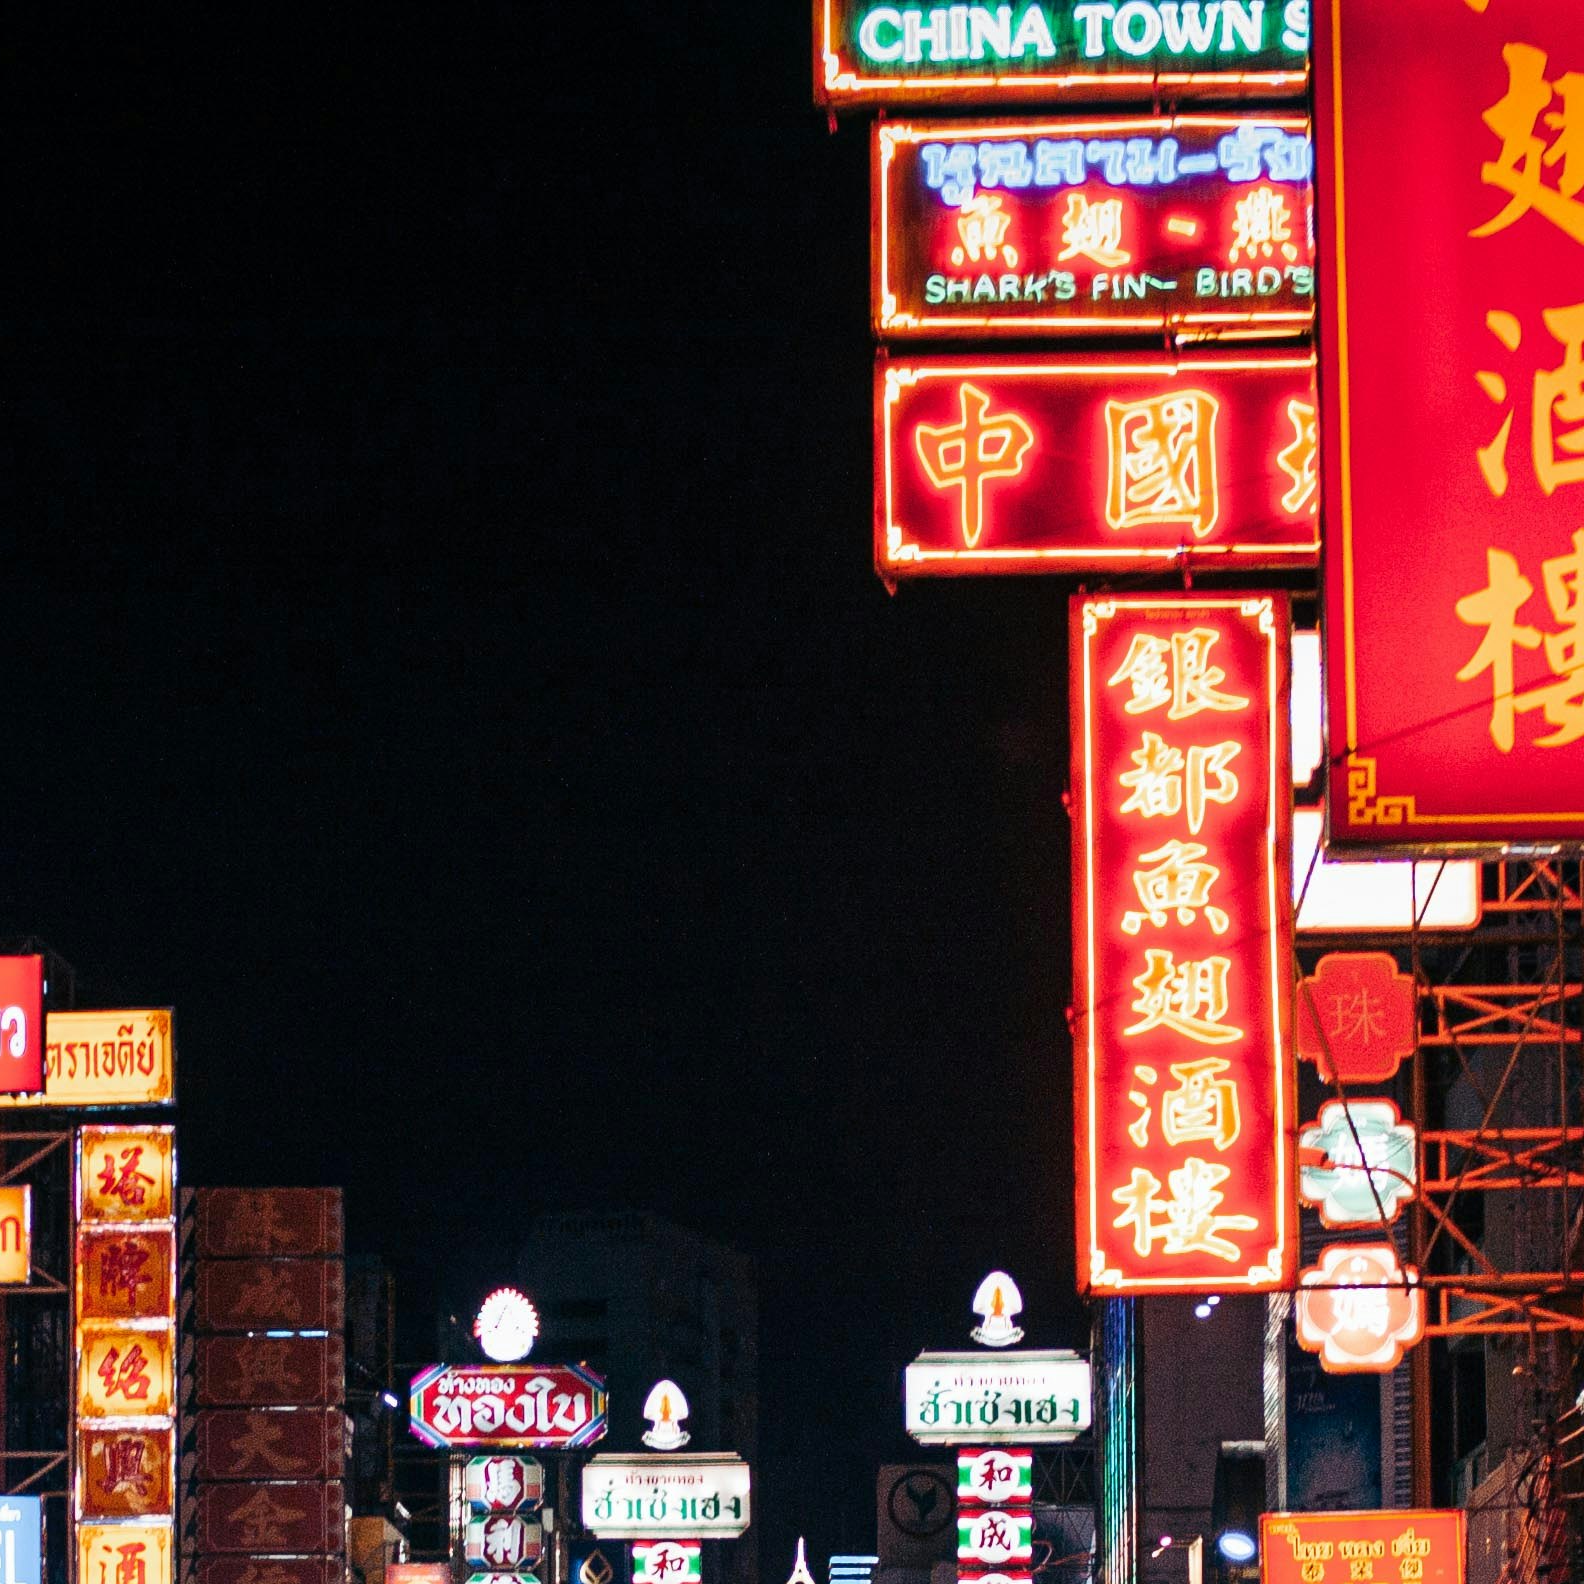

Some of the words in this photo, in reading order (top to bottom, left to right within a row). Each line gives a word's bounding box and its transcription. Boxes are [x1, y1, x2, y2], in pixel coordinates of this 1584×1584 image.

[859, 5, 1056, 62] CHINA
[1075, 0, 1266, 57] TOWN
[925, 272, 1076, 304] SHARK'S
[1107, 628, 1259, 1262] 銀都魚翅酒樓
[46, 1022, 155, 1081] ตราเจดีย์
[432, 1376, 587, 1435] ทองใบ
